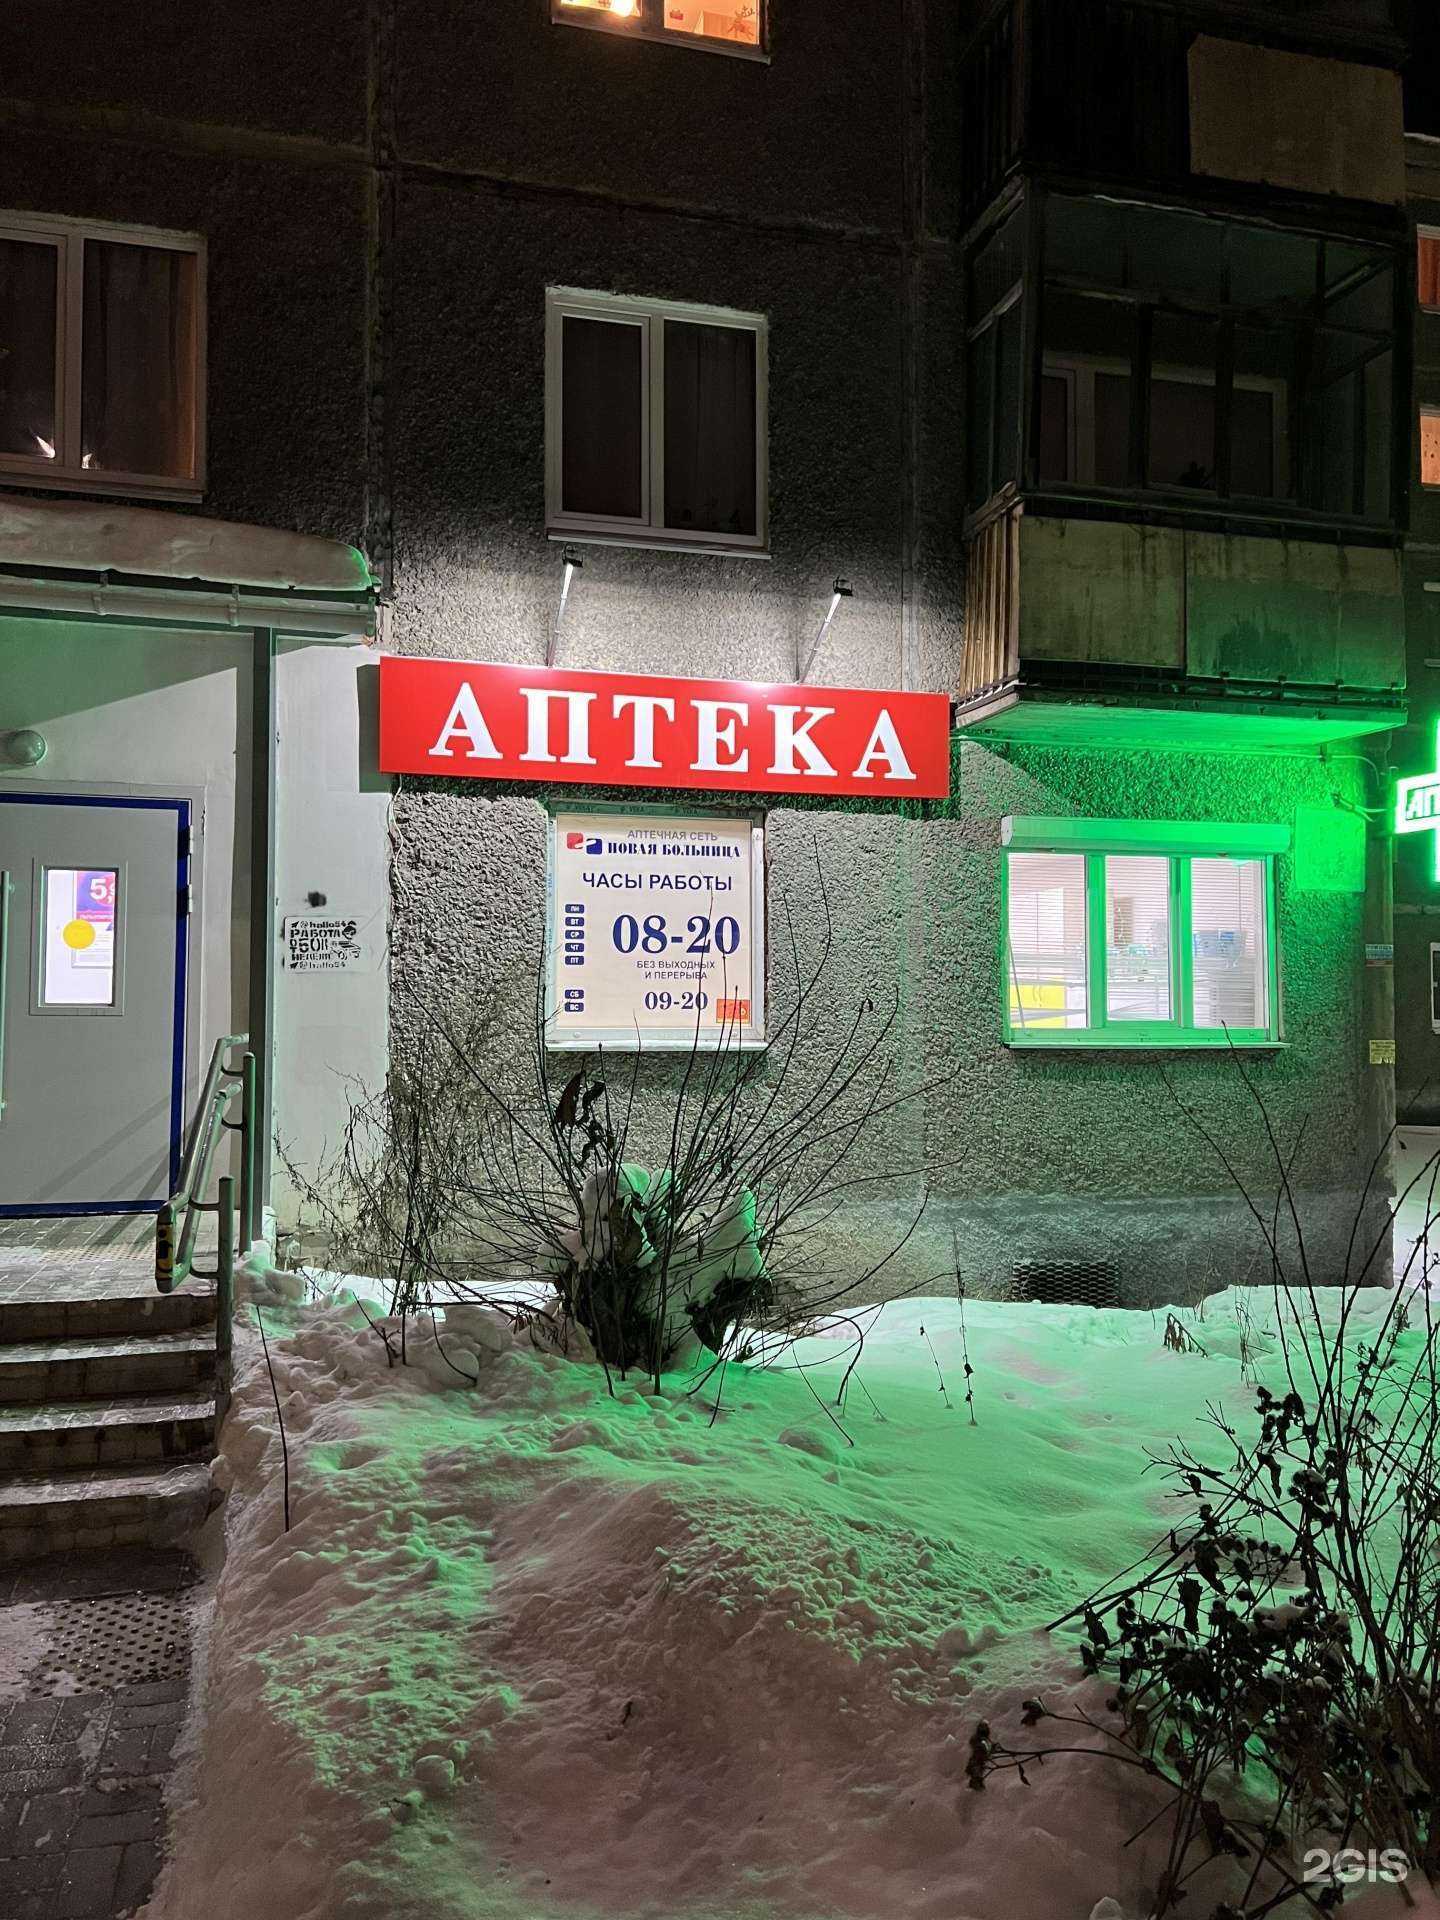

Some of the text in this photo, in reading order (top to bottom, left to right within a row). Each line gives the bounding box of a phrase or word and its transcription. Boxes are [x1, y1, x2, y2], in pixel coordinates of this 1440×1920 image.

[428, 682, 917, 780] АПТЕКА
[627, 829, 718, 841] АПТЕЧНАЯ СЕТЬ
[608, 842, 741, 859] НОВАЯ БОЛЬНИЦА
[583, 872, 732, 891] ЧАСЫ РАБОТЫ
[290, 929, 341, 938] РАБОТА
[612, 914, 741, 955] 08-20
[637, 960, 715, 970] БЕЗ ВЫХОДНЫХ
[654, 972, 708, 980] ПЕРЕРЫВА
[644, 991, 709, 1010] 09-20
